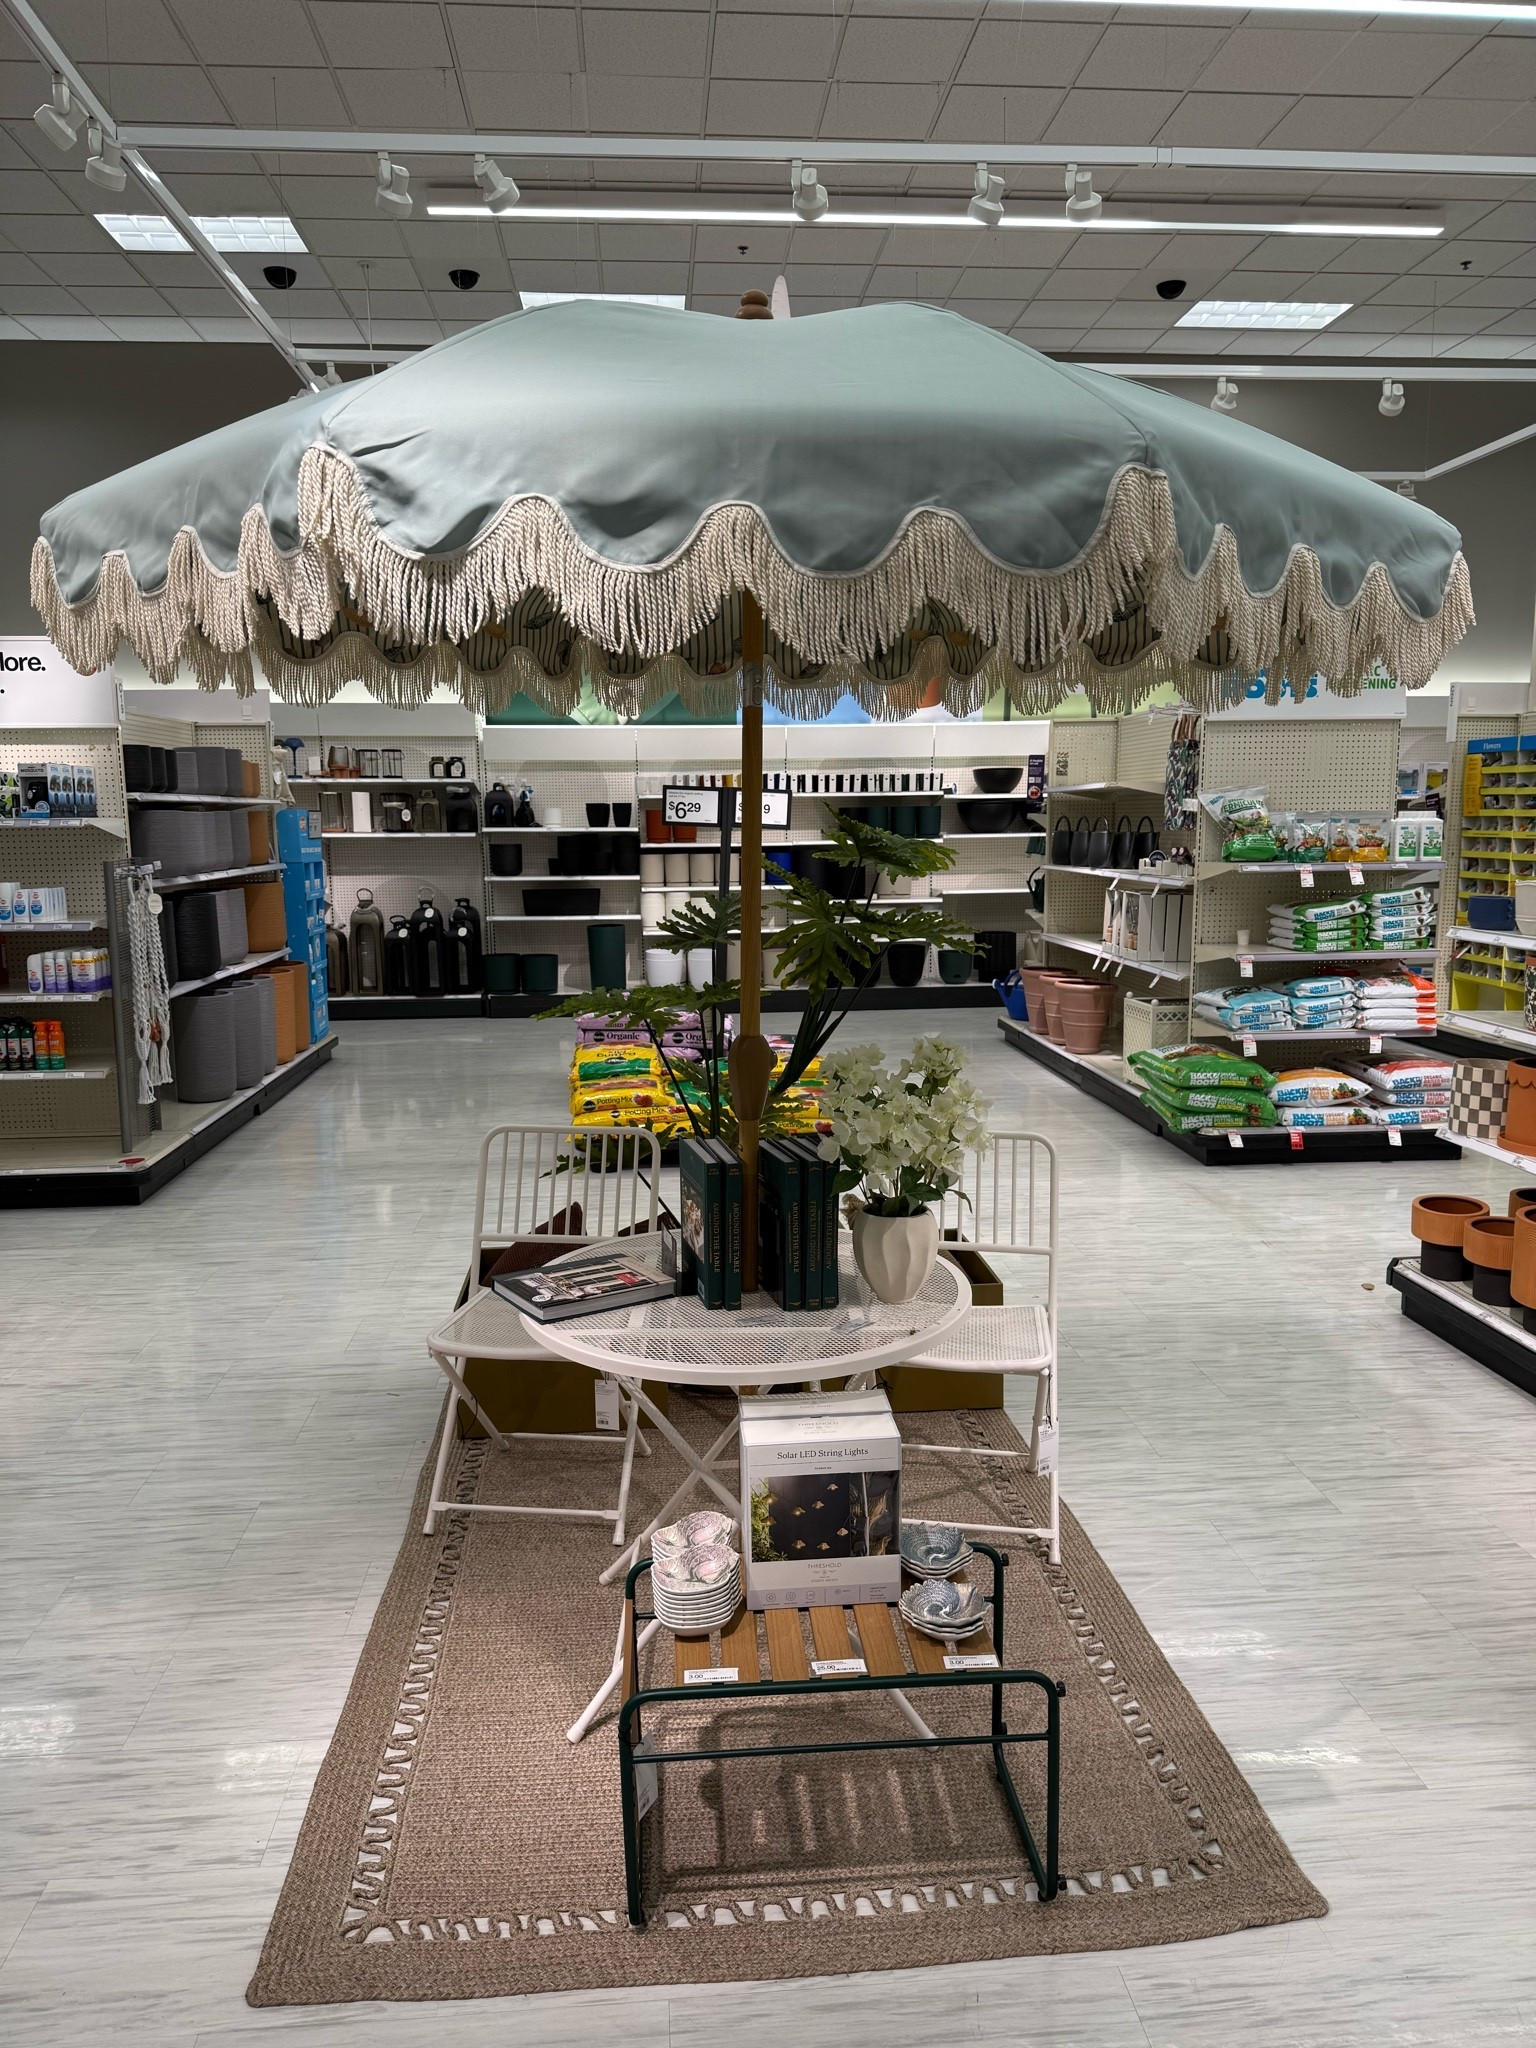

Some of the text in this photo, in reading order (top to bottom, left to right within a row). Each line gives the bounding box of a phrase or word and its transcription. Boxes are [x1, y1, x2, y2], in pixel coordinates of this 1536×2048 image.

[0, 652, 46, 671] ore.
[1222, 799, 1265, 812] ERMICULITE
[606, 1032, 640, 1040] Organic
[1190, 1072, 1214, 1080] BACK
[1189, 1092, 1212, 1101] BACK
[1277, 1088, 1302, 1096] BACK
[1278, 1094, 1308, 1102] ROOTS
[1187, 1099, 1216, 1109] ROOTS
[1181, 1115, 1205, 1124] BACK
[1181, 1121, 1213, 1130] ROOTS
[777, 1447, 869, 1460] Solar LED String Lights
